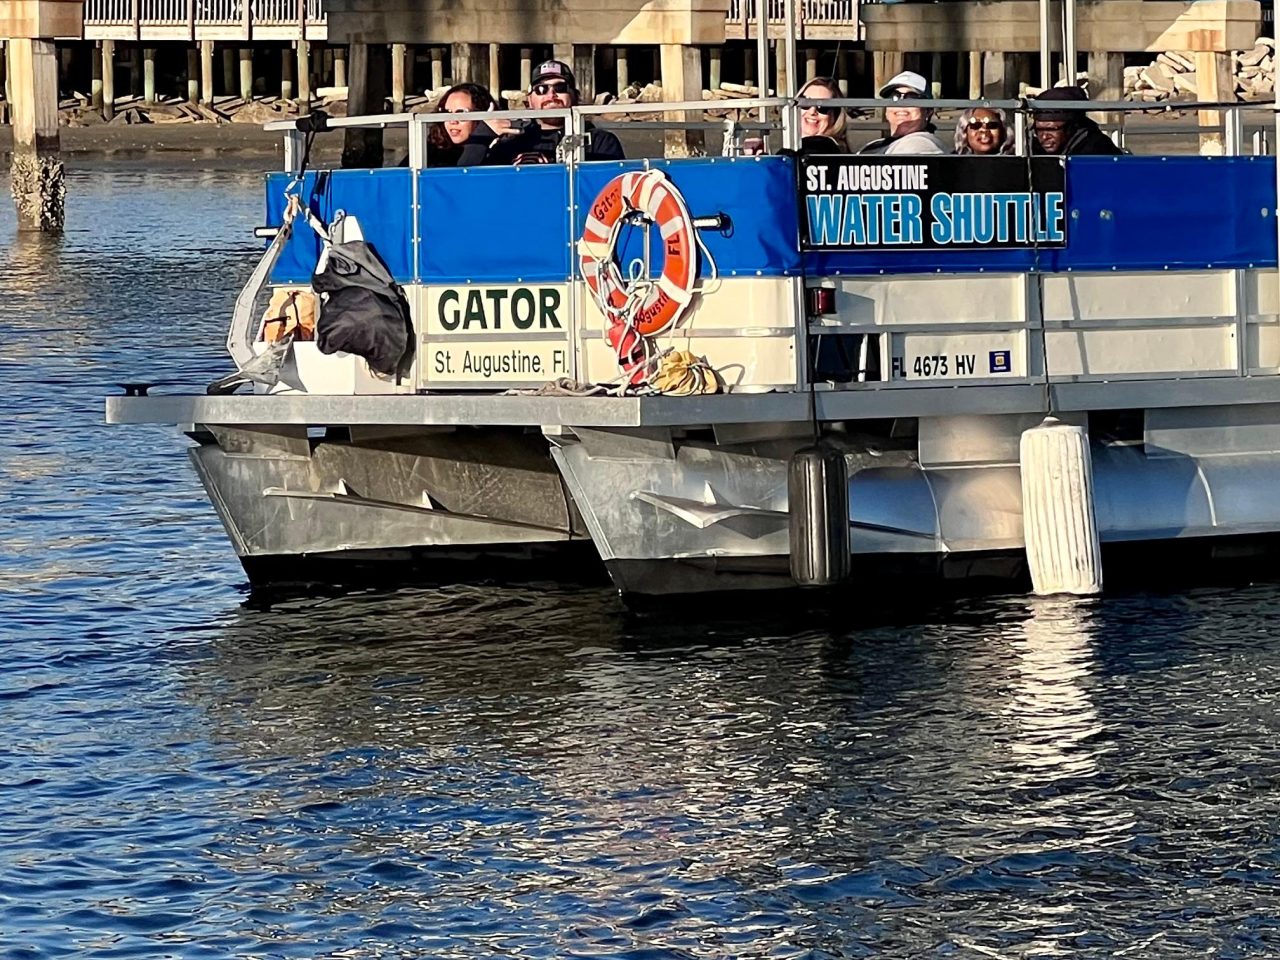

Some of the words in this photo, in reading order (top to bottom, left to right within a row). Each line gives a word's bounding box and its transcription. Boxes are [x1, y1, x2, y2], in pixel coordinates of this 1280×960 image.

[806, 165, 832, 191] ST.
[837, 165, 928, 190] AUGUSTINE
[806, 194, 923, 245] WATER
[931, 192, 1064, 244] SHUTTLE
[438, 288, 562, 331] GATOR
[435, 350, 455, 374] St.
[463, 350, 545, 377] Augustine,
[892, 356, 907, 378] FL
[914, 355, 948, 377] 4673
[956, 354, 976, 375] HV
